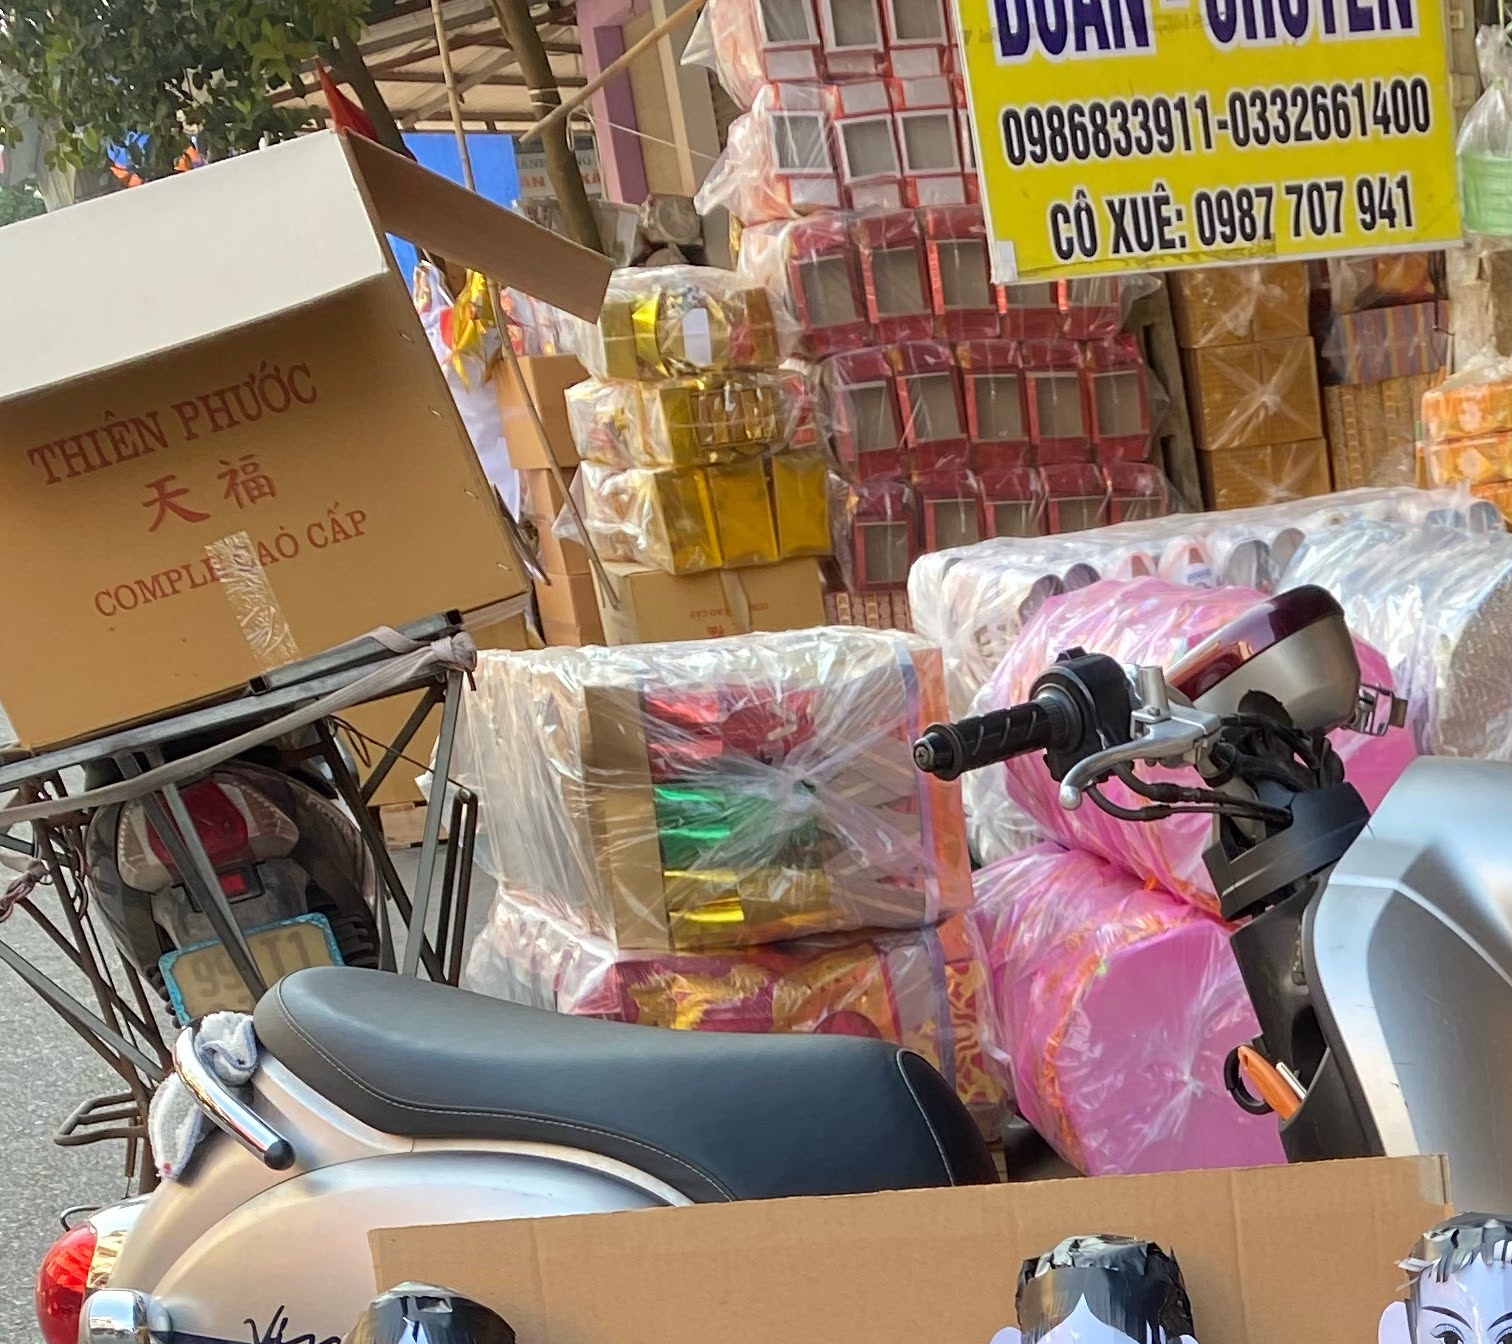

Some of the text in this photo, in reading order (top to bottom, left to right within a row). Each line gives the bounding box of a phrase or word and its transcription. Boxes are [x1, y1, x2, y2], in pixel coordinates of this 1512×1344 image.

[1001, 77, 1431, 166] 0986833911-0332661400
[1049, 174, 1414, 261] CÔ XUÊ: 0987 707 941
[27, 360, 318, 487] THIÊN PHƯỚC
[306, 501, 367, 549] CẤP
